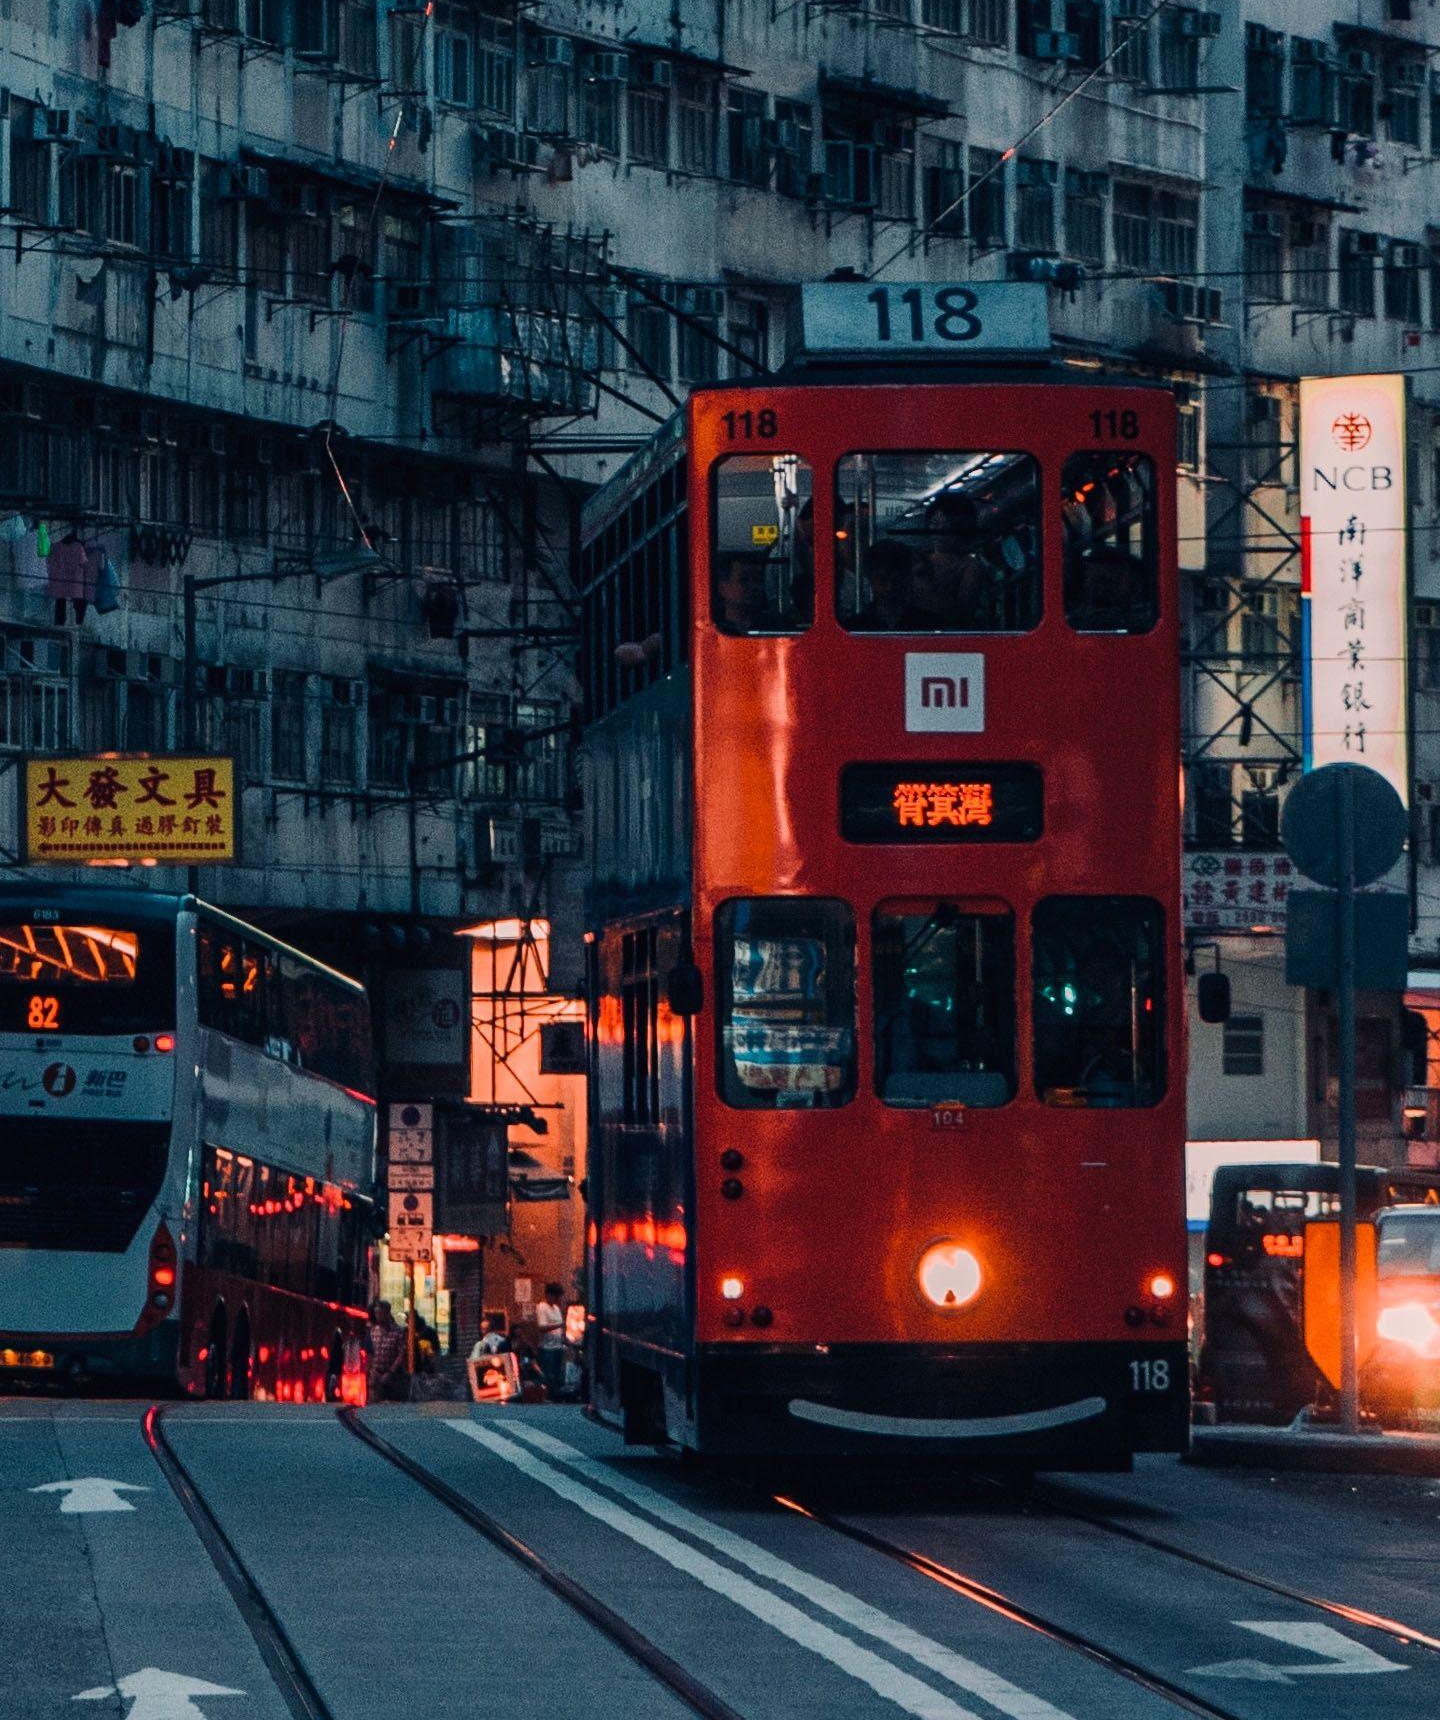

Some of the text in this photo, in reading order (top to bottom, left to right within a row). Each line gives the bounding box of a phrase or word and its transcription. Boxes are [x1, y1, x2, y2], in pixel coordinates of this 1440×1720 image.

[867, 287, 983, 342] 118
[721, 409, 779, 439] 118
[1089, 409, 1140, 440] 118
[1313, 466, 1393, 492] NCB
[1337, 513, 1373, 754] 南洋商業銀行
[36, 766, 226, 810] 大發文具
[893, 783, 992, 826] 筲箕灣
[28, 996, 60, 1028] 82
[1129, 1360, 1169, 1390] 118
